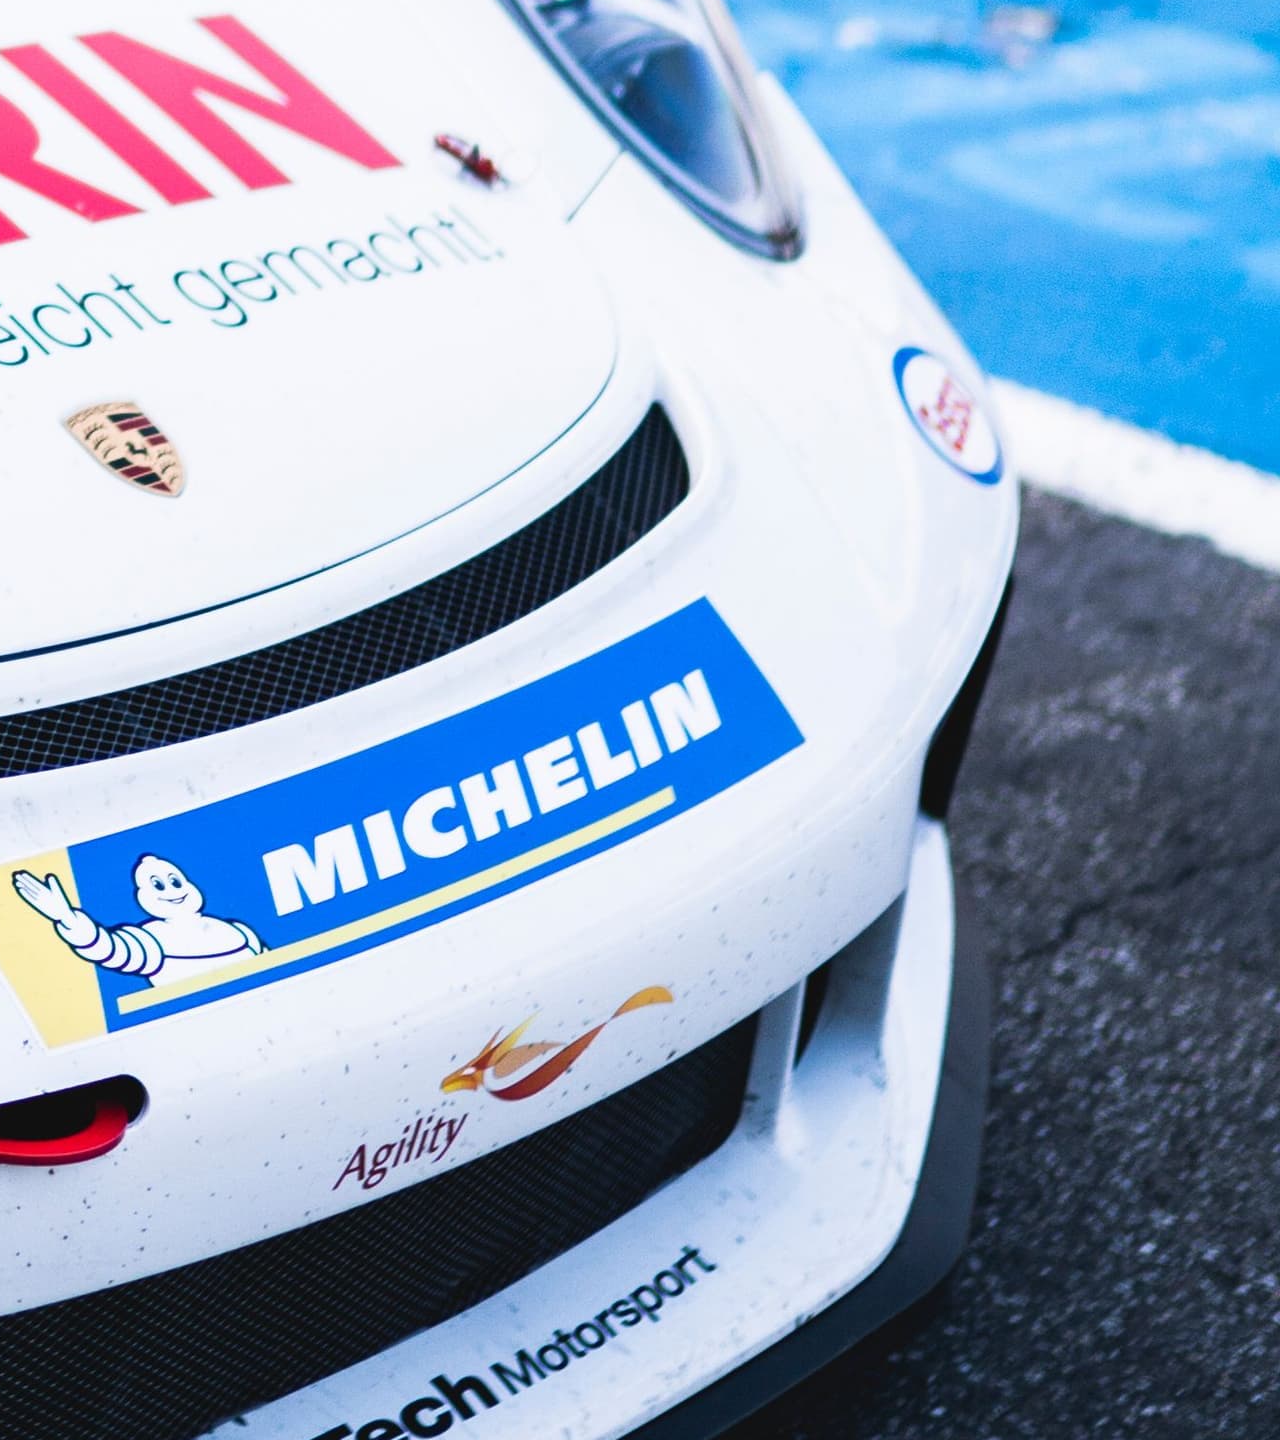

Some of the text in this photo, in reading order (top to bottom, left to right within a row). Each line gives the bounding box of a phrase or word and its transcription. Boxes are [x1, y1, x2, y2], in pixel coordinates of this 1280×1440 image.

[172, 205, 506, 328] gemacht!
[262, 668, 723, 917] MICHELIN
[332, 1113, 468, 1191] Agility
[490, 1244, 718, 1397] Motorsport
